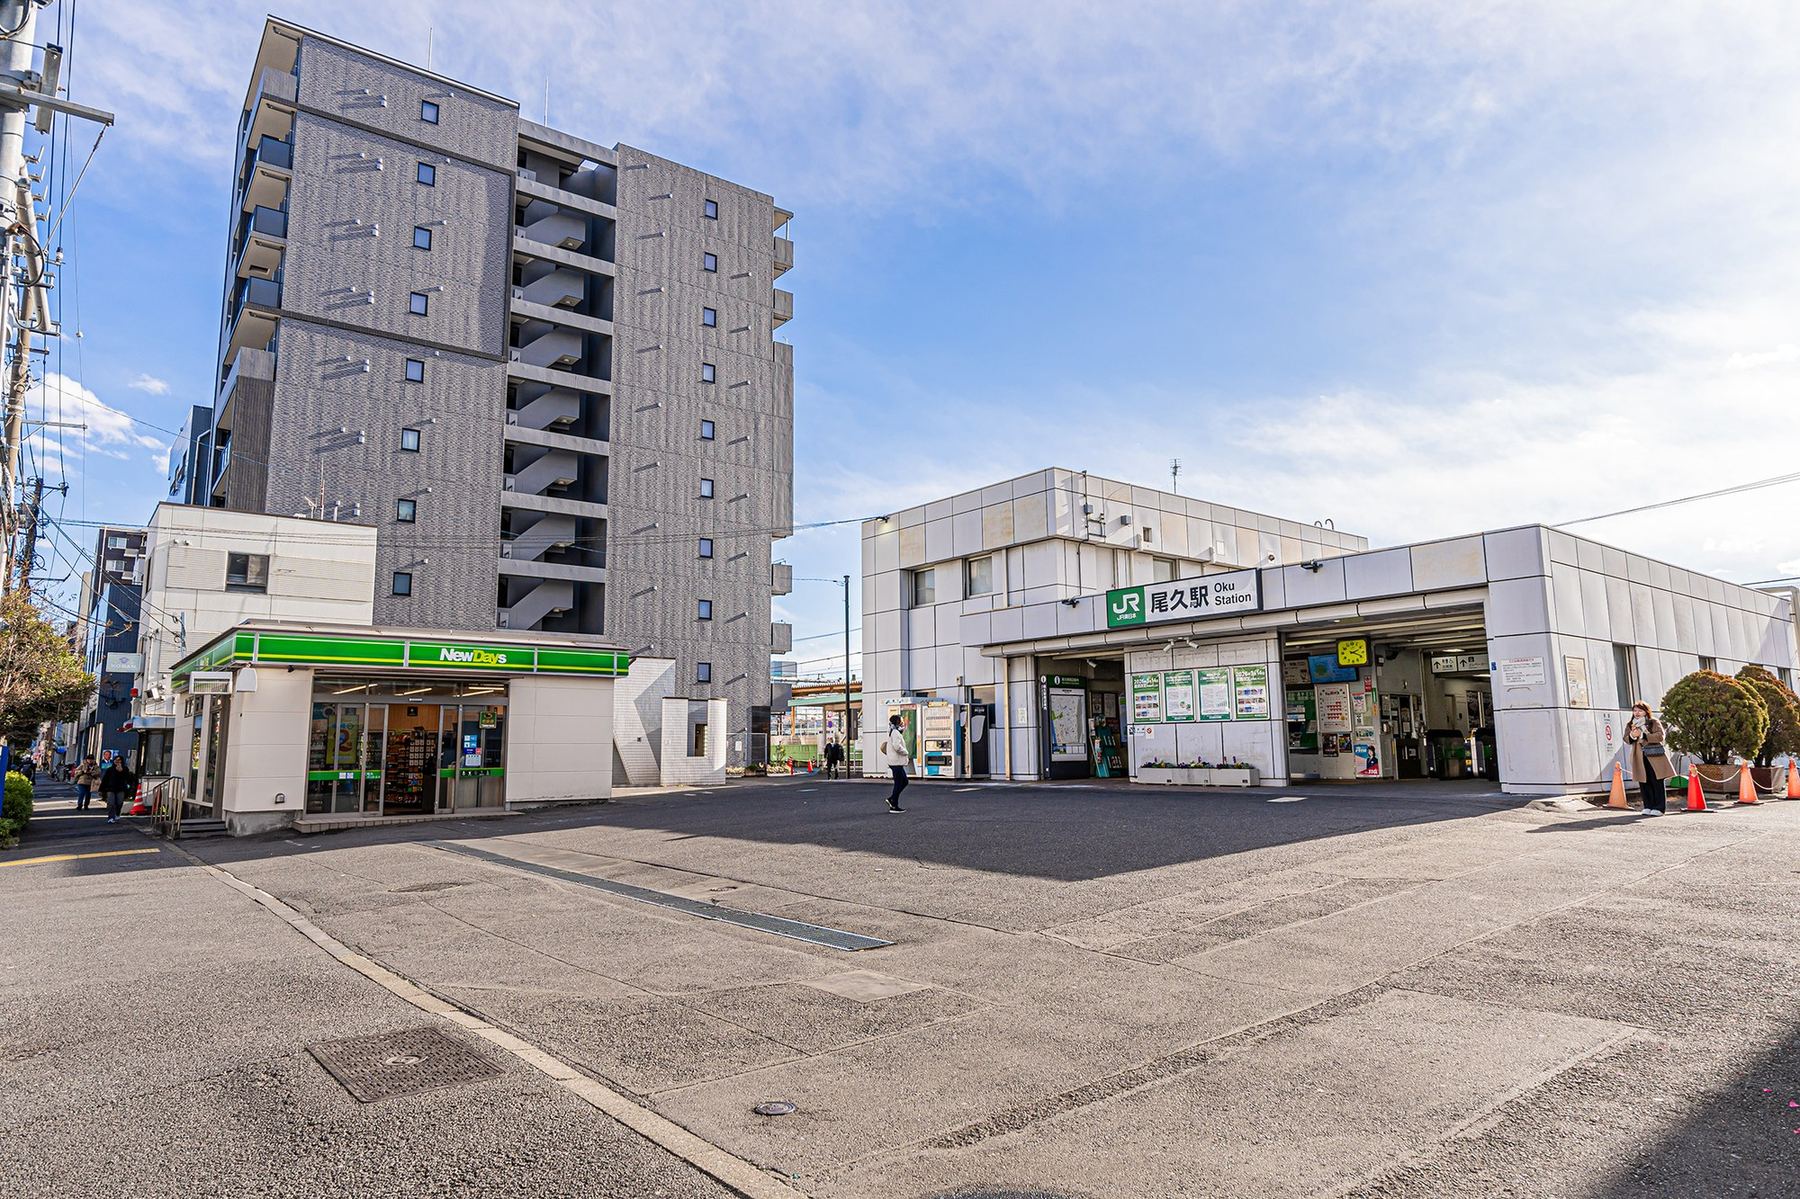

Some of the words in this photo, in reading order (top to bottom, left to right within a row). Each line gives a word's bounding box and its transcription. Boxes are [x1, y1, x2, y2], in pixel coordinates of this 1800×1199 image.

[1214, 582, 1235, 593] Oku
[1113, 593, 1140, 614] JR
[1150, 585, 1209, 613] 尾久駅
[1214, 593, 1252, 606] Station
[440, 648, 507, 665] NewDays
